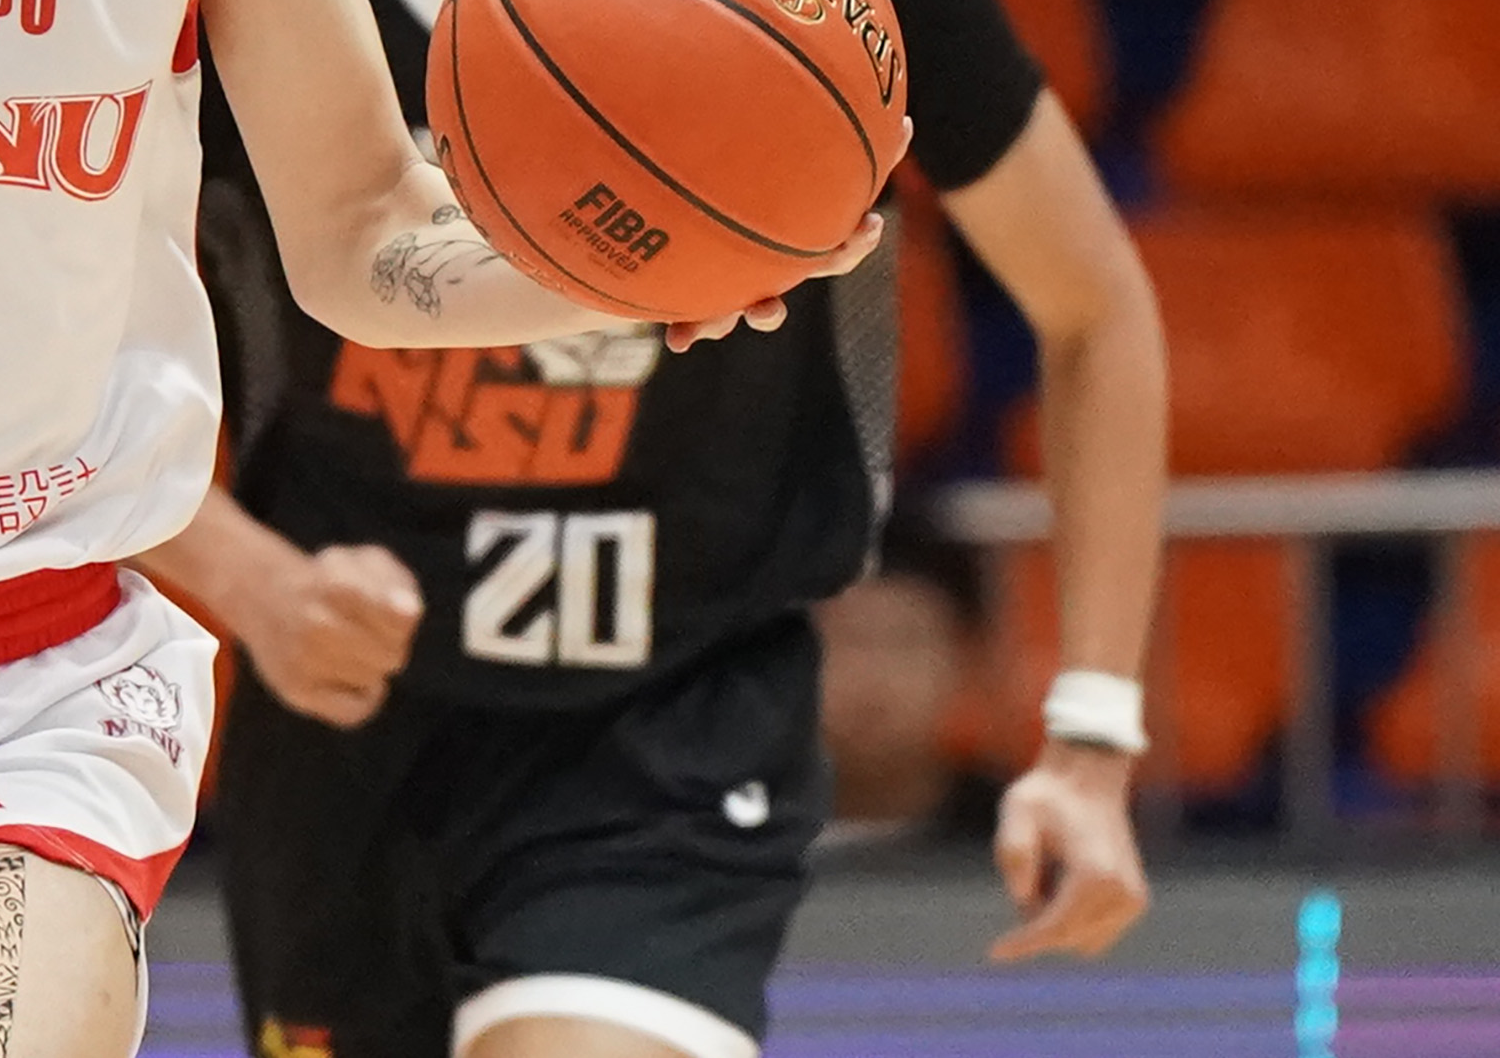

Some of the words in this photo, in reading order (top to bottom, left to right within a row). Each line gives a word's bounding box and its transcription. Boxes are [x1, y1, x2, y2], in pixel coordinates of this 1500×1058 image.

[559, 208, 639, 273] APPROVED
[574, 182, 669, 262] FIBA
[462, 509, 657, 672] 20
[99, 718, 184, 768] NTNU
